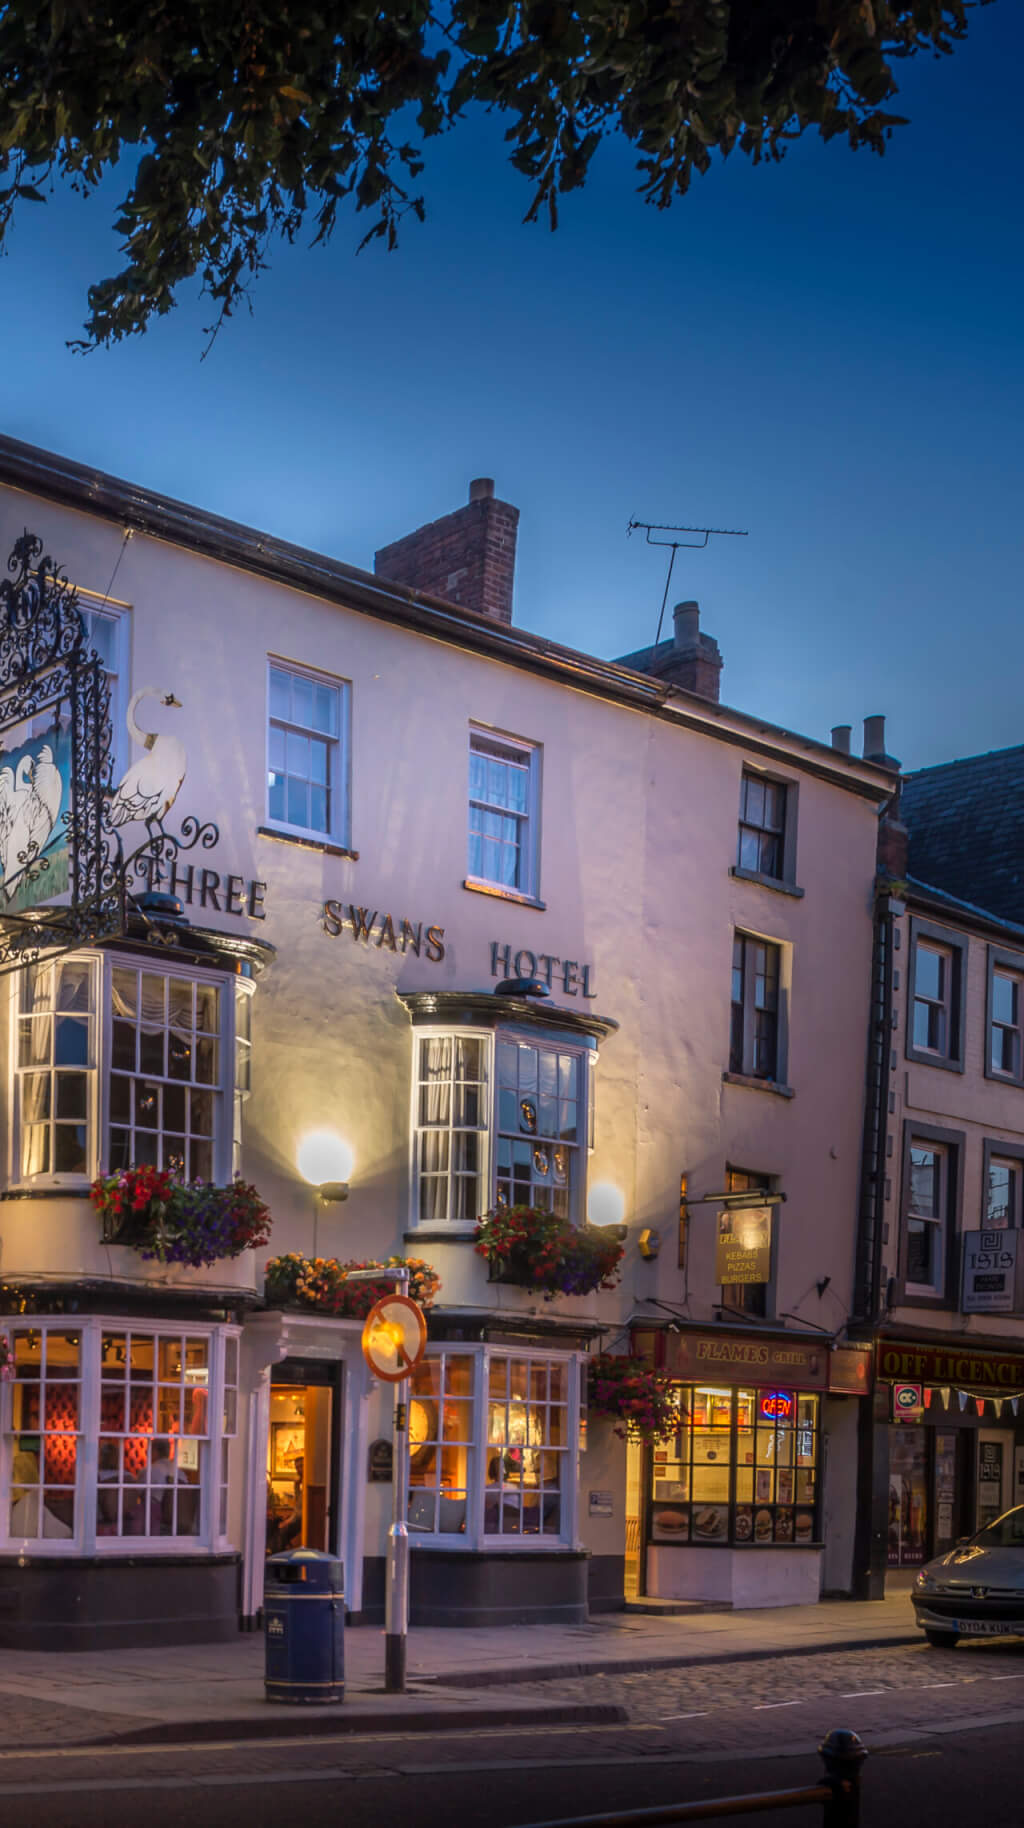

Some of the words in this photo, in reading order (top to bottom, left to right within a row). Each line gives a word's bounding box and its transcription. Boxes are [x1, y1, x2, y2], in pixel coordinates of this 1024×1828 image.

[137, 854, 266, 920] THREE
[323, 899, 445, 962] SWANS
[490, 941, 597, 999] HOTEL
[727, 1261, 757, 1272] PIZZAS
[967, 1251, 1015, 1270] ISIS
[720, 1273, 762, 1284] BURGERS
[697, 1340, 769, 1365] FLAMES
[773, 1350, 809, 1365] GRILL
[883, 1351, 928, 1376] OFF
[937, 1357, 1024, 1387] LICENCE
[763, 1398, 791, 1415] OPEN
